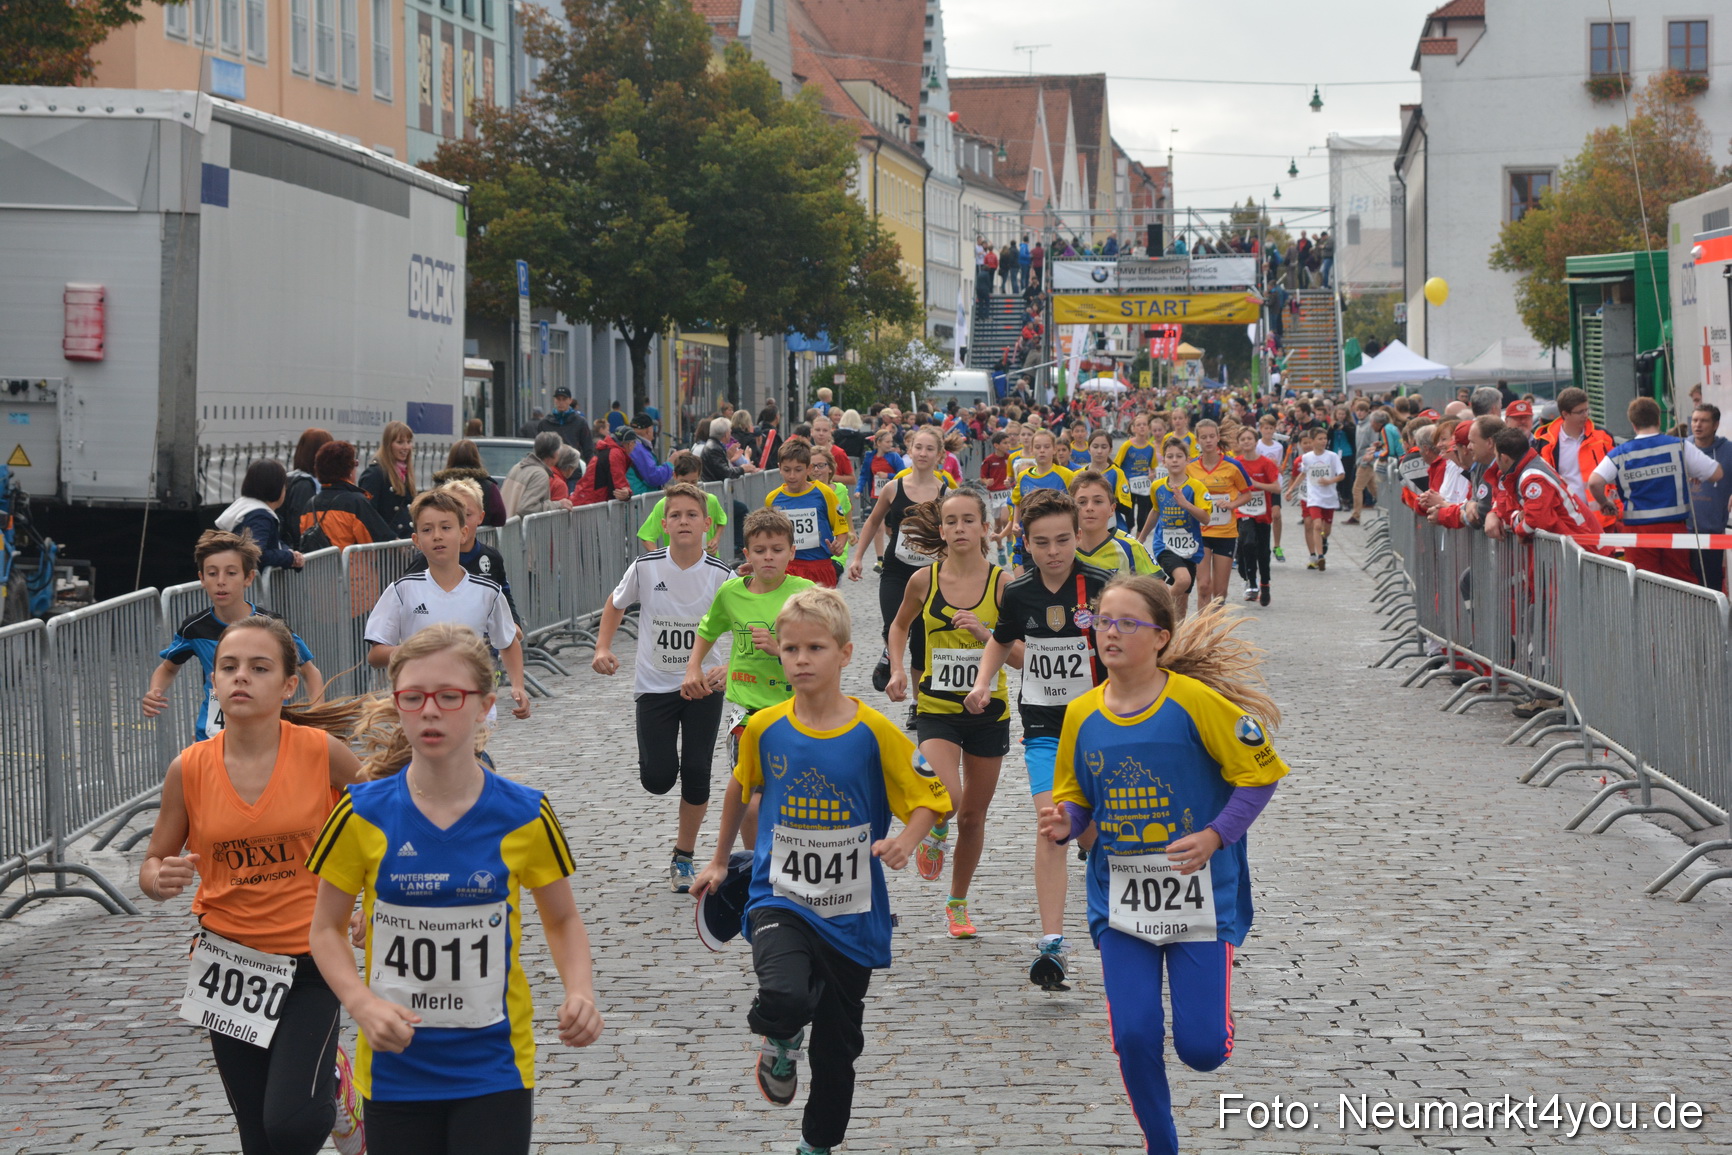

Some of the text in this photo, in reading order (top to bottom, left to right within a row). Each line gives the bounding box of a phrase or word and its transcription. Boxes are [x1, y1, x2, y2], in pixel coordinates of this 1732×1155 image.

[408, 253, 455, 325] BOCK
[1121, 300, 1191, 316] START
[1311, 469, 1329, 477] 4004
[1623, 464, 1677, 480] SEG-LEITER
[1132, 480, 1151, 489] 4010
[1168, 537, 1196, 549] 4023
[653, 619, 672, 627] PARTL
[662, 654, 691, 664] Sebast
[933, 653, 955, 662] PARTL
[1029, 654, 1084, 680] 4042
[938, 664, 979, 688] 400
[1043, 686, 1067, 697] Marc
[1254, 744, 1273, 763] PAR
[1258, 753, 1278, 768] Neum
[774, 833, 855, 849] PARTL Neumarkt
[225, 842, 295, 871] OEXL
[781, 848, 858, 885] 4041
[1111, 864, 1142, 874] PARTL
[262, 870, 296, 881] VISION
[400, 882, 441, 891] LANGE
[1121, 875, 1205, 913] 4024
[789, 890, 853, 907] bastian
[375, 912, 484, 932] PARTL Neumarkt
[1136, 921, 1188, 936] Luciana
[198, 939, 288, 977] PARTL Neumarkt
[384, 934, 489, 982] 4011
[198, 961, 290, 1021] 4030
[411, 993, 464, 1010] Merle
[201, 1010, 259, 1043] Michelle
